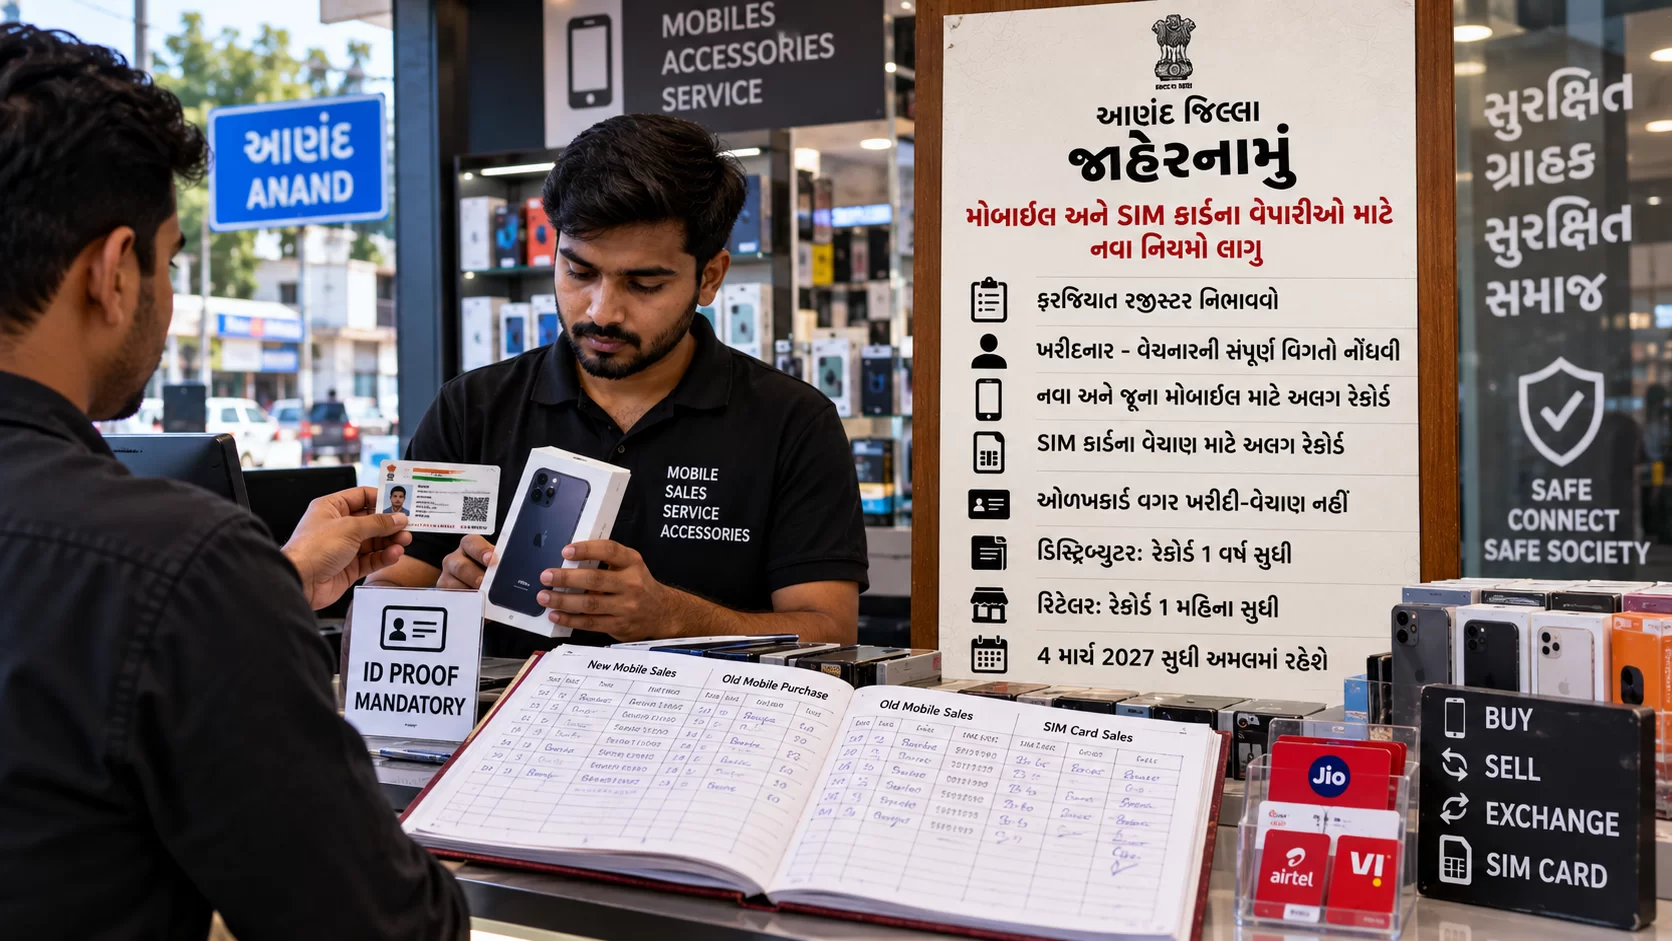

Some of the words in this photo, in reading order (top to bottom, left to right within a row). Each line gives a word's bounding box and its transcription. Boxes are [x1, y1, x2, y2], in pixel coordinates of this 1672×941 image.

[662, 1, 776, 38] MOBILES
[661, 32, 835, 75] ACCESSORIES
[661, 78, 763, 112] SERVICE
[1484, 67, 1633, 141] સુરક્ષિત
[1096, 97, 1176, 127] આણંદ
[1184, 94, 1260, 125] જિલ્લા
[243, 111, 354, 165] આણંદ
[1068, 123, 1297, 190] જાહેરનામું
[1485, 142, 1596, 192] ગ્રાહક
[246, 170, 354, 210] ANAND
[965, 199, 1056, 227] મોબાઈલ
[1064, 198, 1108, 227] અને
[1117, 204, 1165, 227] SIM
[1173, 197, 1240, 226] કાર્ડના
[1249, 196, 1344, 225] વેપારીઓ
[1352, 196, 1394, 225] માટે
[1484, 195, 1632, 268] સુરક્ષિત
[1090, 240, 1132, 260] નવા
[1141, 231, 1208, 259] નિયમો
[1216, 239, 1264, 268] લાગુ
[1037, 285, 1118, 313] ફરજિયાત
[1124, 292, 1192, 314] રજીસ્ટર
[1199, 286, 1278, 310] નિભાવવો
[1485, 272, 1607, 318] સમાજ
[1035, 335, 1114, 360] ખરીદનાર
[1137, 336, 1219, 360] વેચનારની
[1225, 336, 1276, 367] સંપૂર્ણ
[1281, 336, 1337, 361] વિગતો
[1343, 337, 1400, 362] નોંધવી
[1036, 388, 1071, 405] નવા
[1077, 381, 1113, 405] અને
[1119, 388, 1158, 413] જૂના
[1165, 381, 1241, 406] મોબાઈલ
[1247, 382, 1281, 407] માટે
[1287, 390, 1340, 407] અલગ
[1347, 383, 1391, 408] રેકોર્ડ
[1037, 433, 1076, 452] SIM
[1083, 428, 1135, 453] કાર્ડના
[1141, 429, 1197, 456] વેચાણ
[1203, 429, 1237, 454] માટે
[1242, 437, 1295, 455] અલગ
[1301, 430, 1345, 455] રેકોર્ડ
[667, 465, 719, 482] MOBILE
[664, 484, 707, 501] SALES
[1036, 485, 1131, 511] ઓળખકાર્ડ
[1137, 494, 1179, 511] વગર
[1185, 487, 1305, 515] ખરીદી-વેચાણ
[1312, 488, 1350, 515] નહીં
[1531, 478, 1593, 502] SAFE
[662, 504, 720, 521] SERVICE
[1507, 508, 1620, 532] CONNECT
[660, 523, 750, 543] ACCESSORIES
[1037, 537, 1143, 569] ડિસ્ટ્રિબ્યુટર:
[1151, 538, 1195, 563] રેકોર્ડ
[1201, 545, 1210, 563] 1
[1218, 539, 1248, 564] વર્ષ
[1253, 540, 1292, 571] સુધી
[1484, 538, 1541, 562] SAFE
[1547, 539, 1651, 565] SOCIETY
[1037, 590, 1101, 615] રિટેલર:
[1108, 591, 1152, 616] રેકોર્ડ
[1159, 598, 1168, 617] 1
[1176, 593, 1233, 619] મહિના
[1240, 594, 1279, 625] સુધી
[587, 658, 613, 672] New
[612, 662, 648, 675] Mobile
[650, 666, 677, 678] Sales
[1037, 646, 1051, 665] 4
[1058, 641, 1096, 666] માર્ચ
[1102, 647, 1155, 667] 2027
[1161, 644, 1199, 675] સુધી
[1206, 647, 1278, 670] અમલમાં
[1284, 645, 1328, 672] રહેશે
[363, 661, 384, 683] ID
[389, 662, 460, 687] PROOF
[722, 674, 741, 686] Old
[742, 676, 779, 692] Mobile
[780, 681, 829, 702] Purchase
[354, 691, 467, 716] MANDATORY
[879, 699, 901, 710] Old
[901, 701, 941, 716] Mobile
[943, 707, 974, 721] Sales
[1043, 721, 1068, 734] SIM
[1070, 725, 1099, 739] Card
[1101, 729, 1133, 743] Sales
[1485, 706, 1534, 732] BUY
[1312, 764, 1346, 786] Jio
[1484, 754, 1541, 782] SELL
[1486, 801, 1620, 837] EXCHANGE
[1269, 868, 1314, 888] airtel
[1486, 852, 1530, 881] SIM
[1538, 858, 1608, 889] CARD
